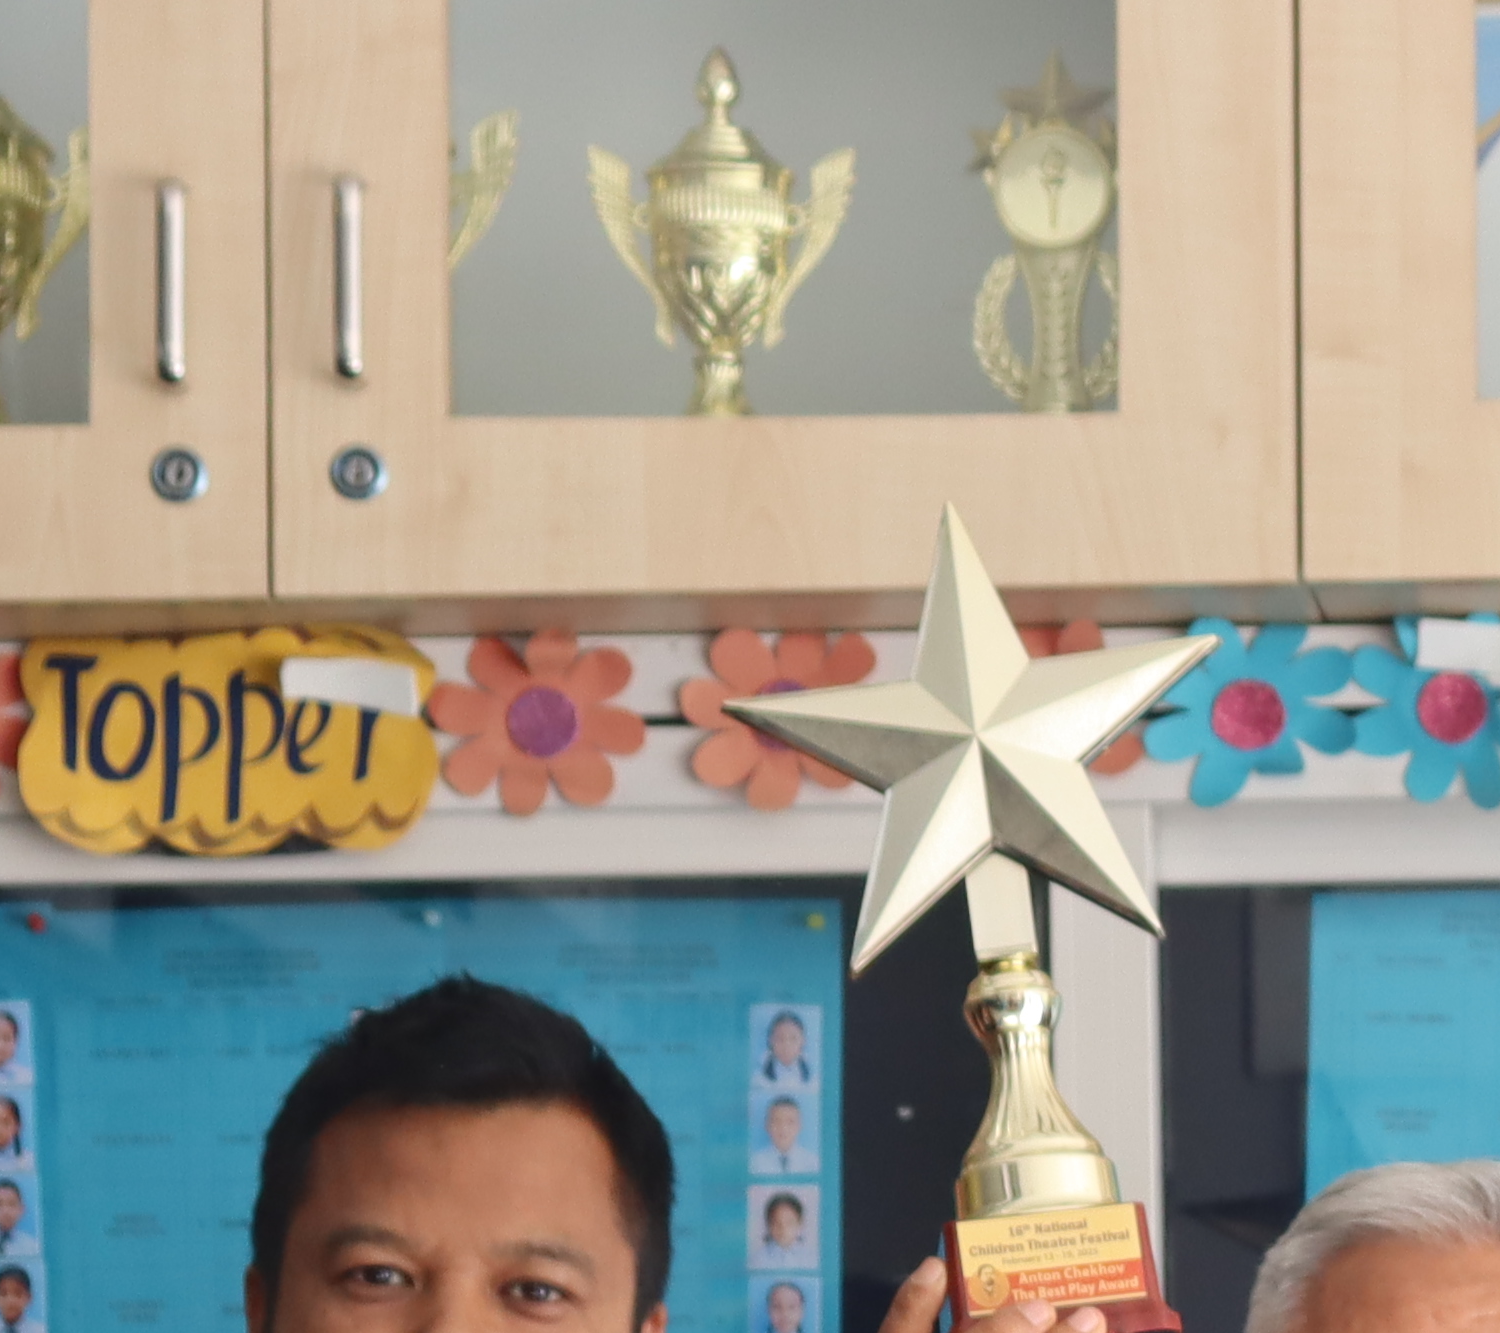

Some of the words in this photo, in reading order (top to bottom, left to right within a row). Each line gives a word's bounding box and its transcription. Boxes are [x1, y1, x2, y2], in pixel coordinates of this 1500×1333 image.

[1034, 1219, 1088, 1235] National
[968, 1241, 1025, 1257] Children
[1027, 1235, 1077, 1250] Theatre
[1080, 1229, 1131, 1245] Festival
[1019, 1268, 1061, 1284] Anton
[1063, 1261, 1126, 1279] Chekhov
[1011, 1287, 1035, 1301] The
[1037, 1283, 1066, 1299] Best
[1068, 1280, 1096, 1298] Play
[1098, 1275, 1140, 1292] Award
